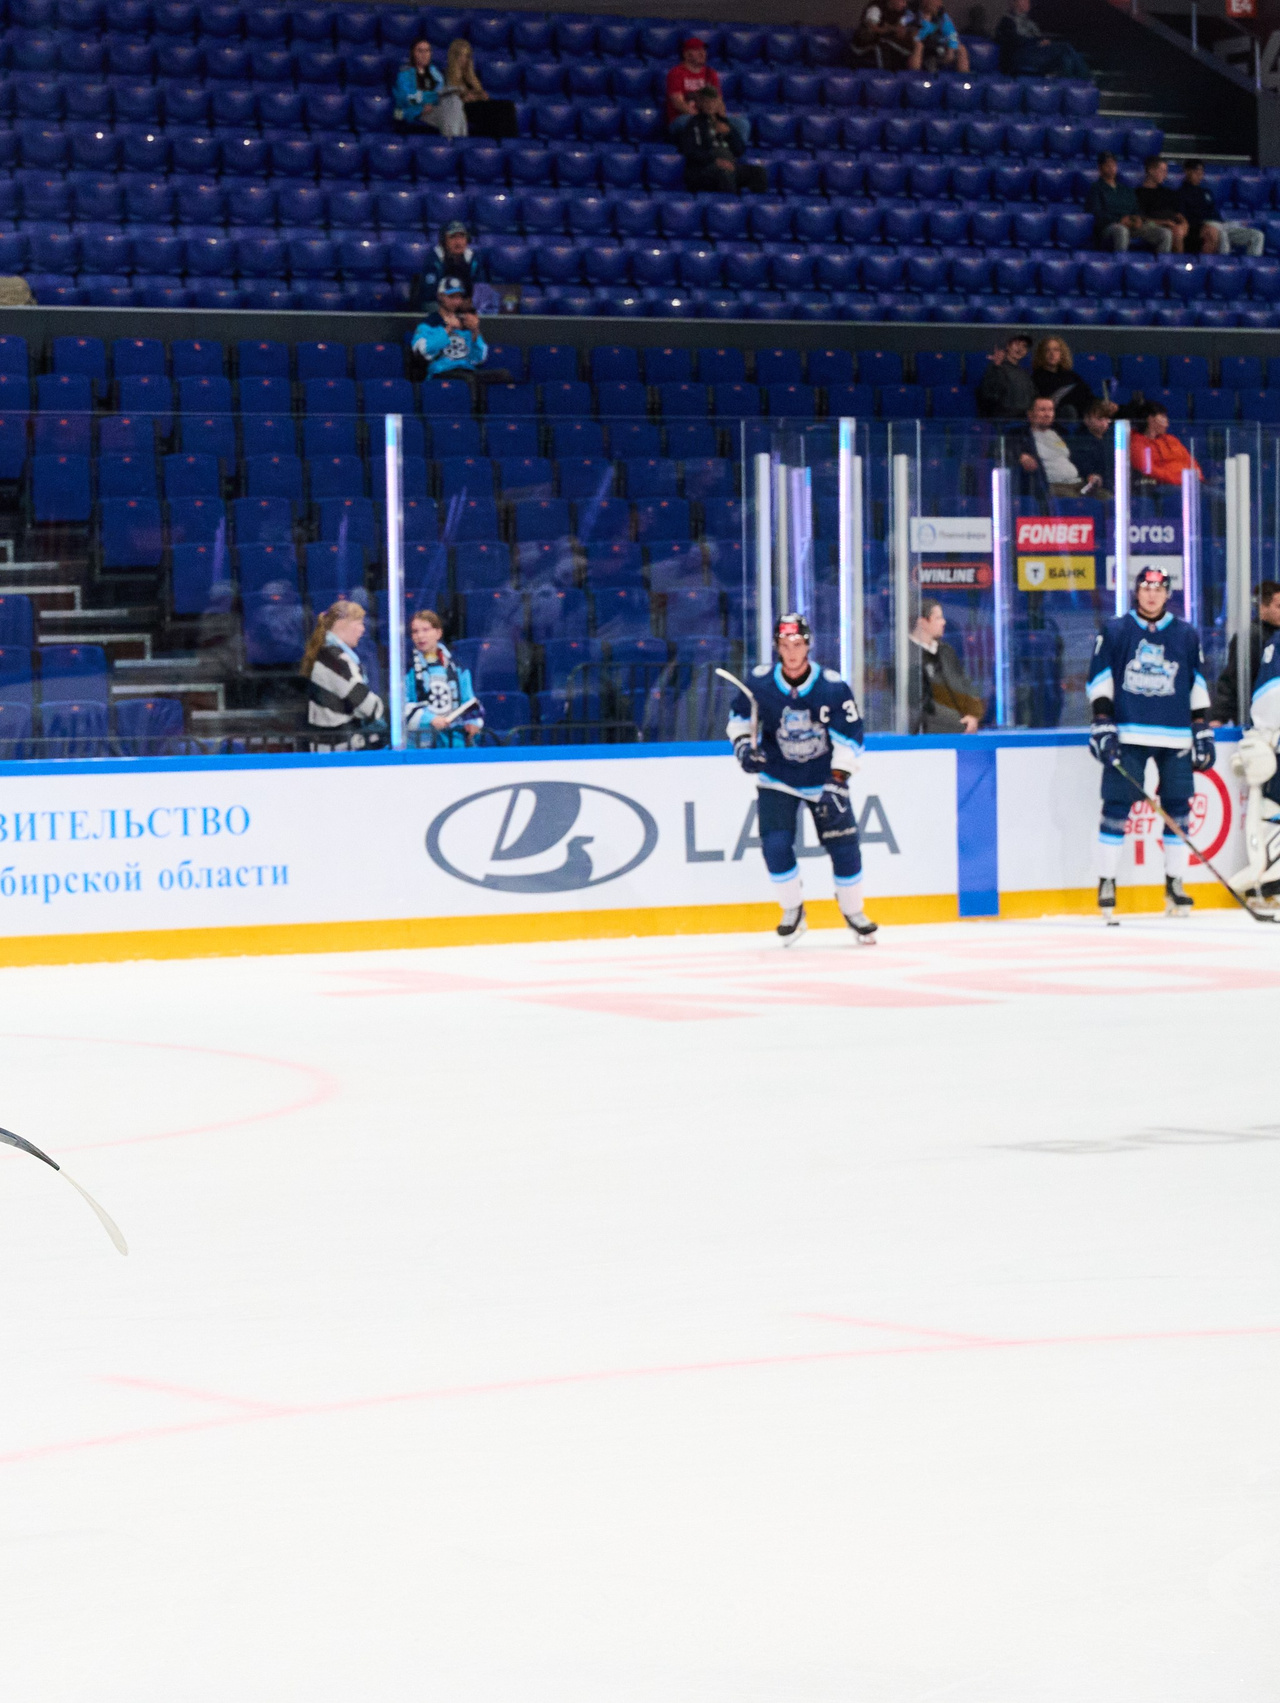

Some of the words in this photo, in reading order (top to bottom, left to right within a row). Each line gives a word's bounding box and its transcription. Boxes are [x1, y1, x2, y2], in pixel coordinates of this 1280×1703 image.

[1018, 523, 1093, 545] FONBET
[1115, 525, 1175, 543] огаз
[920, 567, 976, 583] WINLINE
[1048, 567, 1086, 579] БАНК
[158, 860, 290, 891] области
